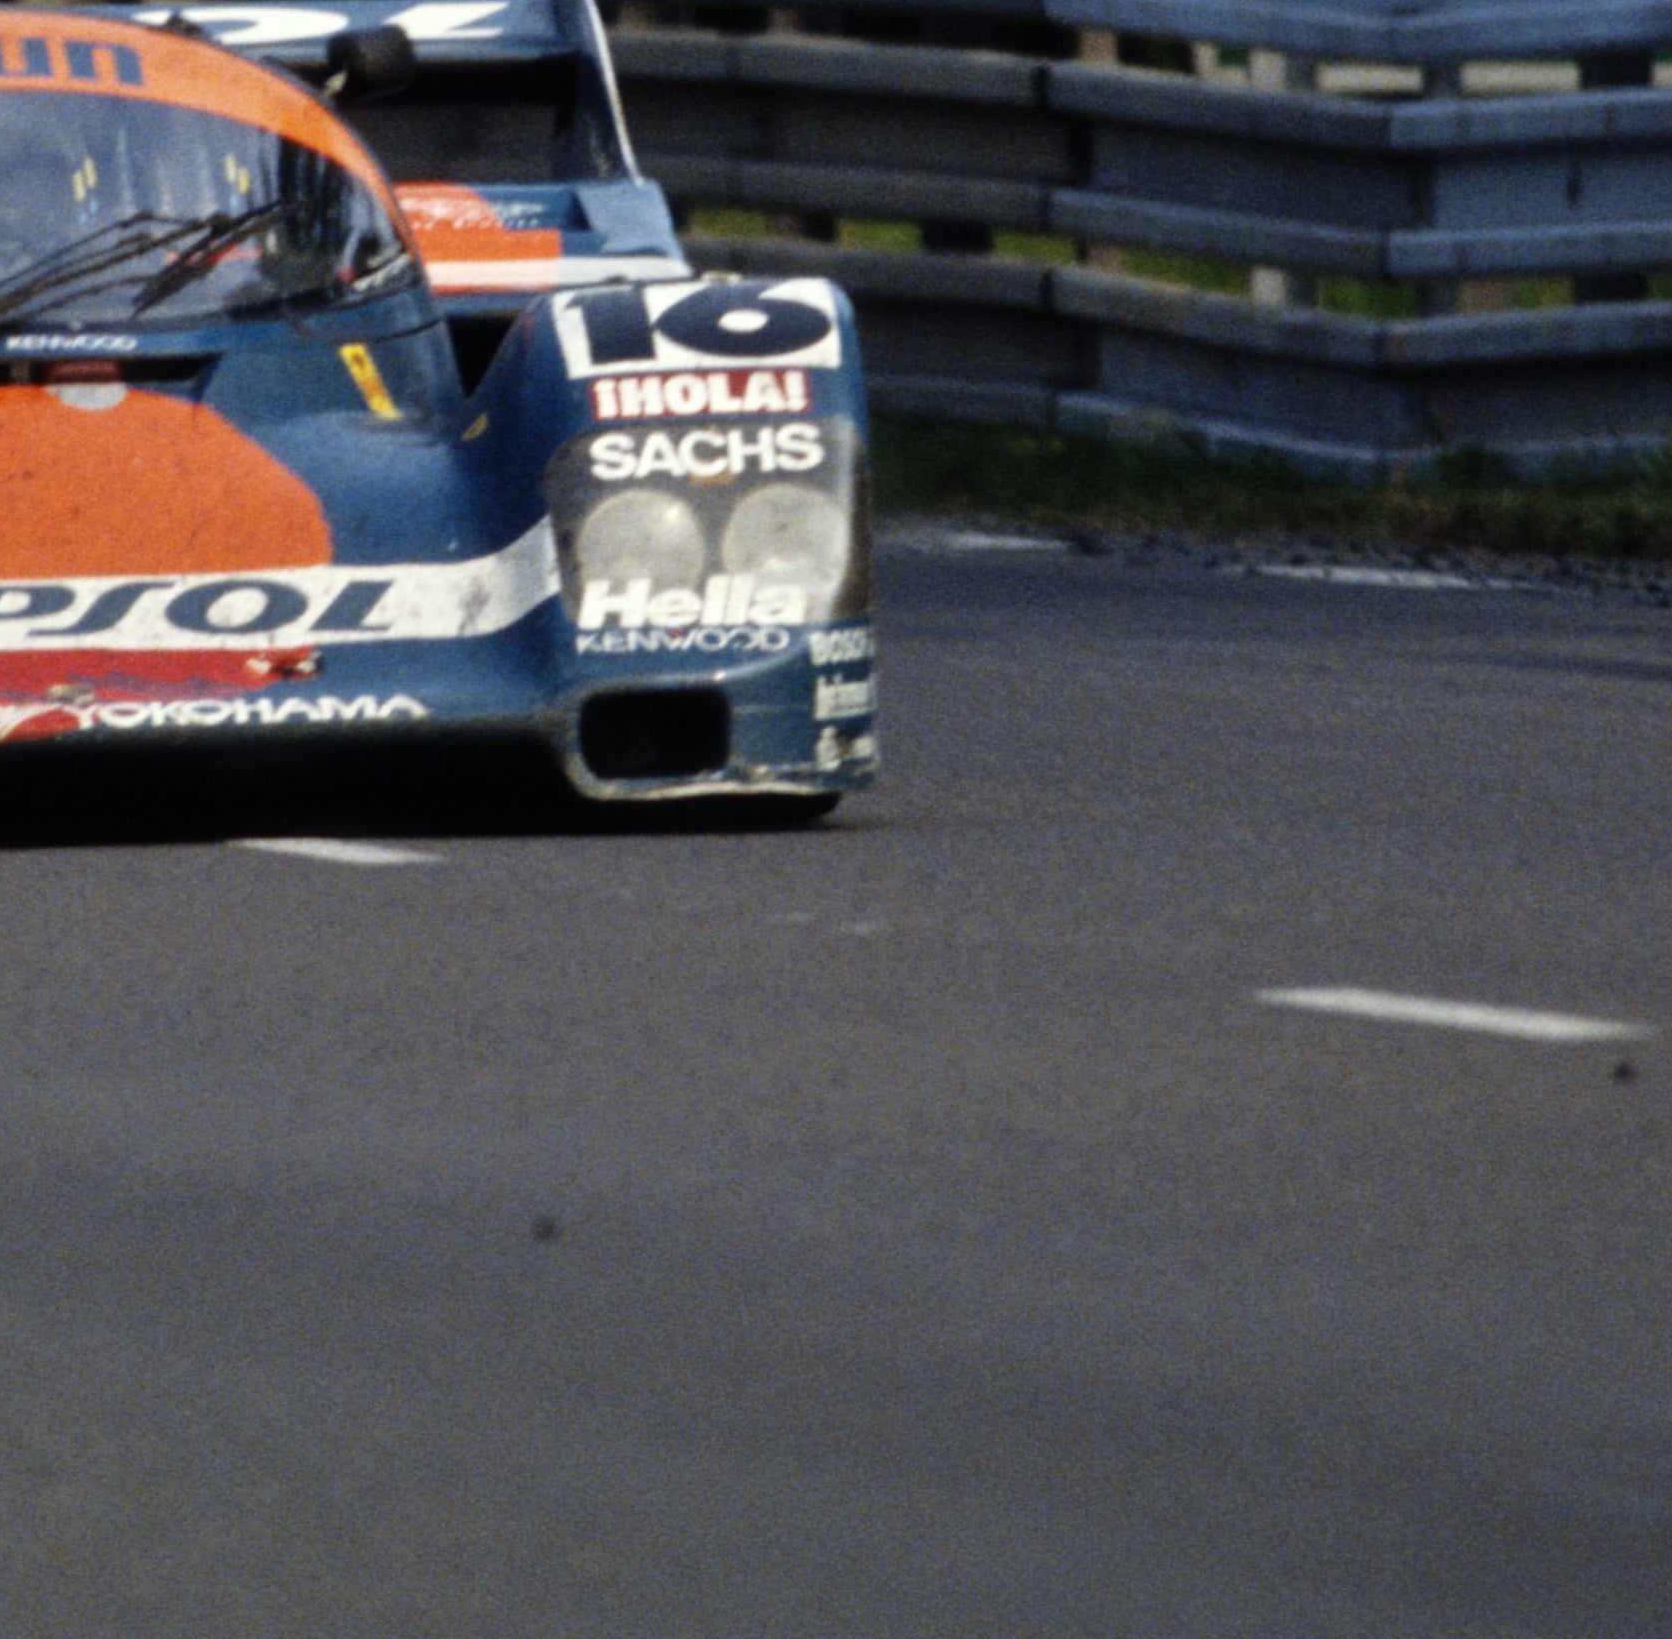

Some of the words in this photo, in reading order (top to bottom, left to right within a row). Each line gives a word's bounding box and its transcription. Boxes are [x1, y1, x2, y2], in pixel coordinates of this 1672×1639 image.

[563, 281, 834, 364] 16
[589, 424, 825, 480] SACHS
[578, 575, 811, 630] Hella
[575, 628, 790, 653] KENWOOD
[61, 695, 429, 731] YOKOHAMA
